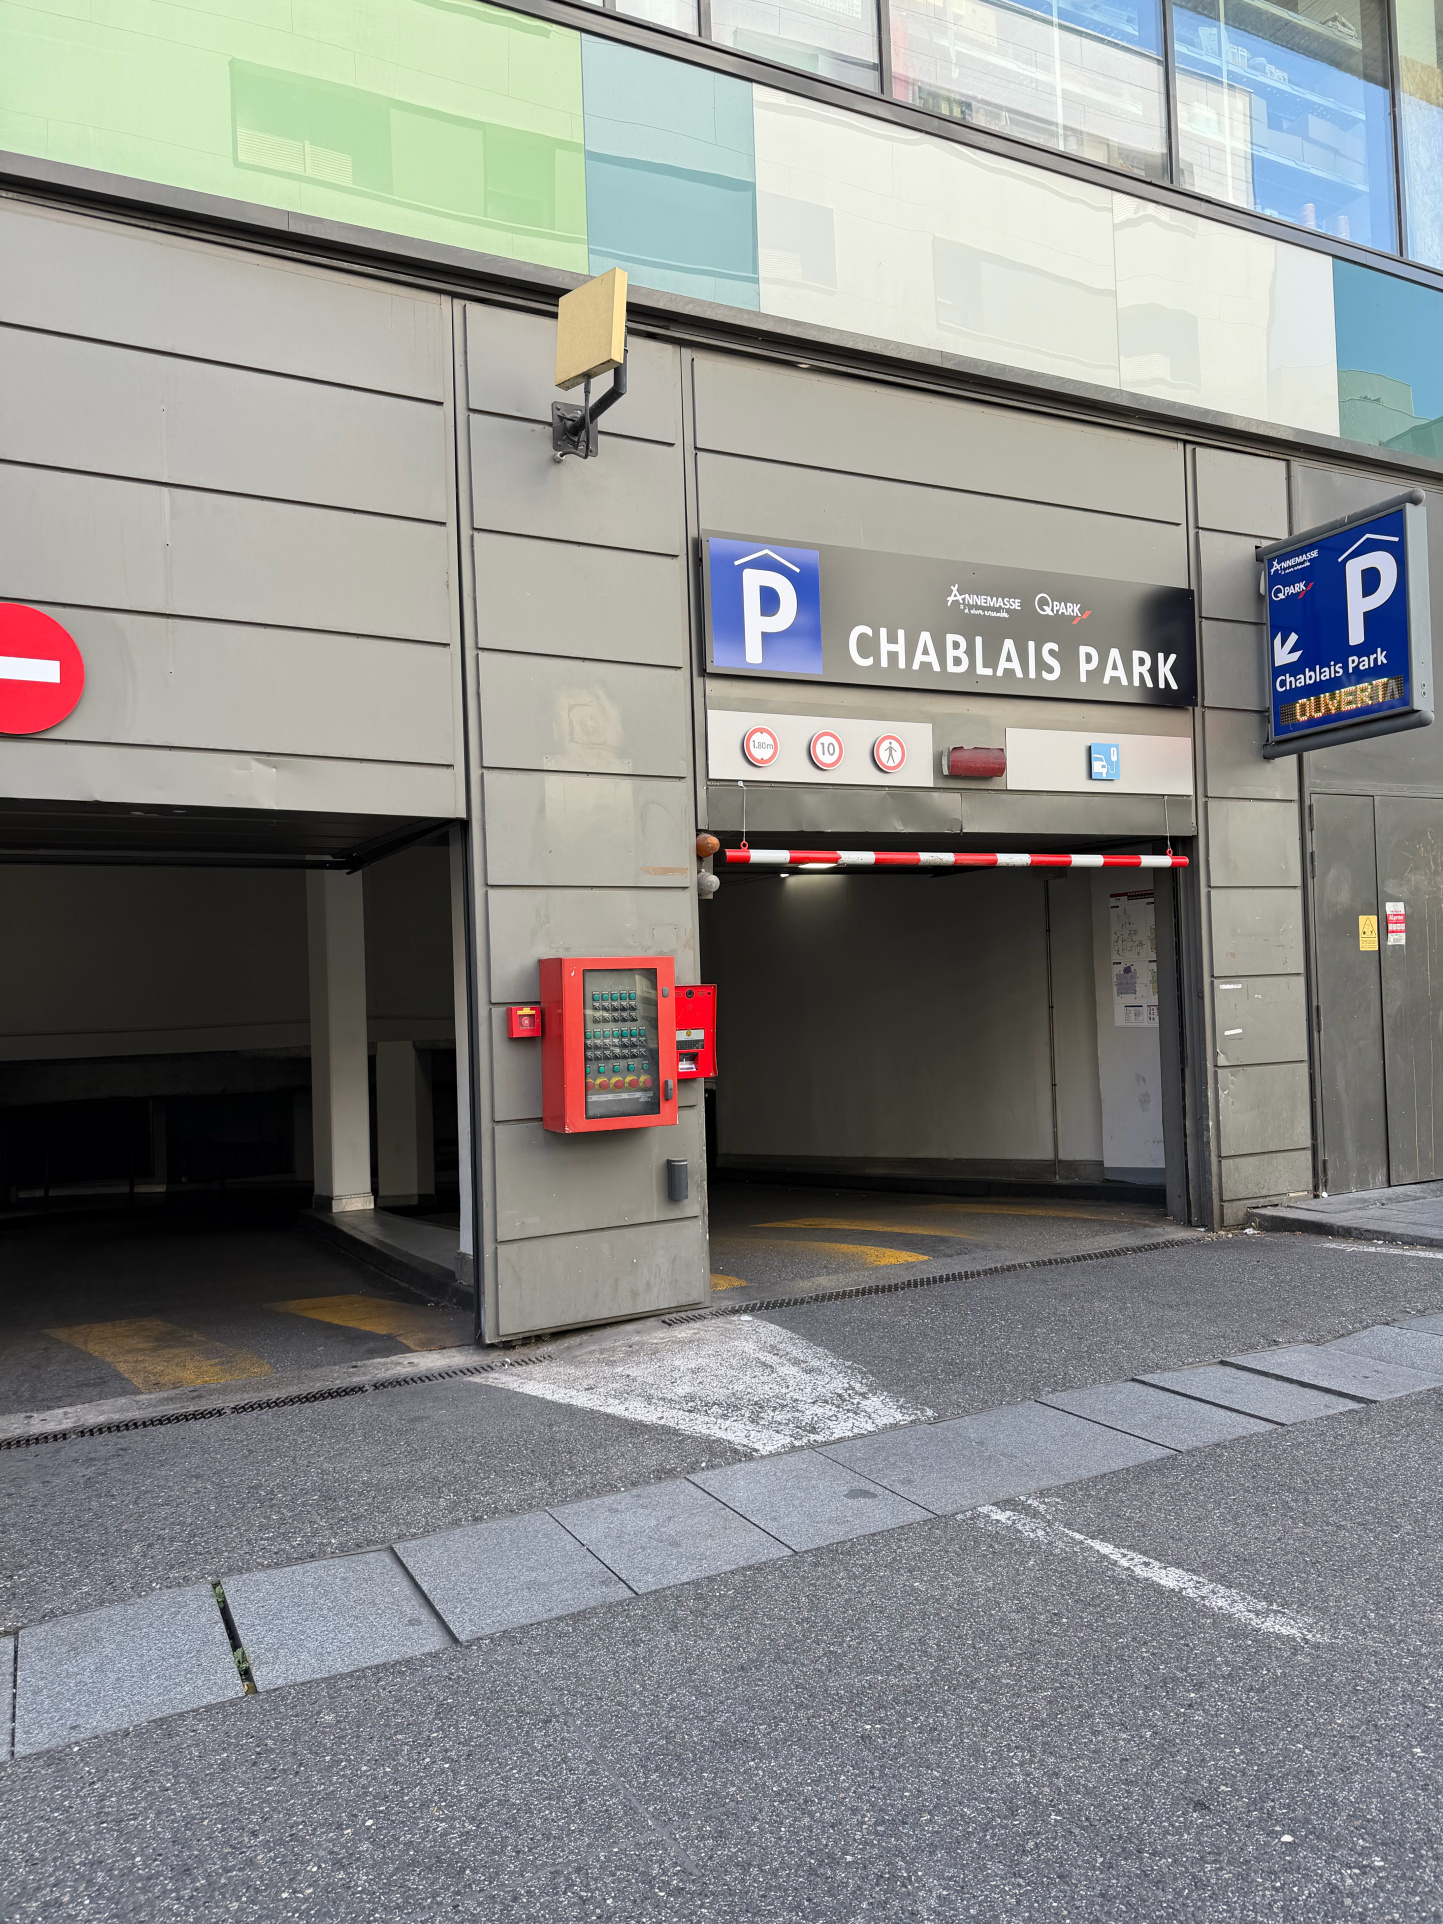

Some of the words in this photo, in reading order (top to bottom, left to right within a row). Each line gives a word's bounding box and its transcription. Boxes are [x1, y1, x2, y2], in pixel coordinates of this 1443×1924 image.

[1270, 549, 1319, 576] ANNEMASSE
[742, 567, 798, 664] P
[946, 584, 1021, 610] ANNEMASSE
[1345, 550, 1398, 646] P
[848, 624, 1061, 681] CHABLAIS
[1078, 645, 1179, 690] PARK
[1275, 660, 1344, 692] Chablais
[1348, 647, 1388, 674] Park
[1295, 677, 1389, 722] OUVERT
[820, 742, 836, 756] 10
